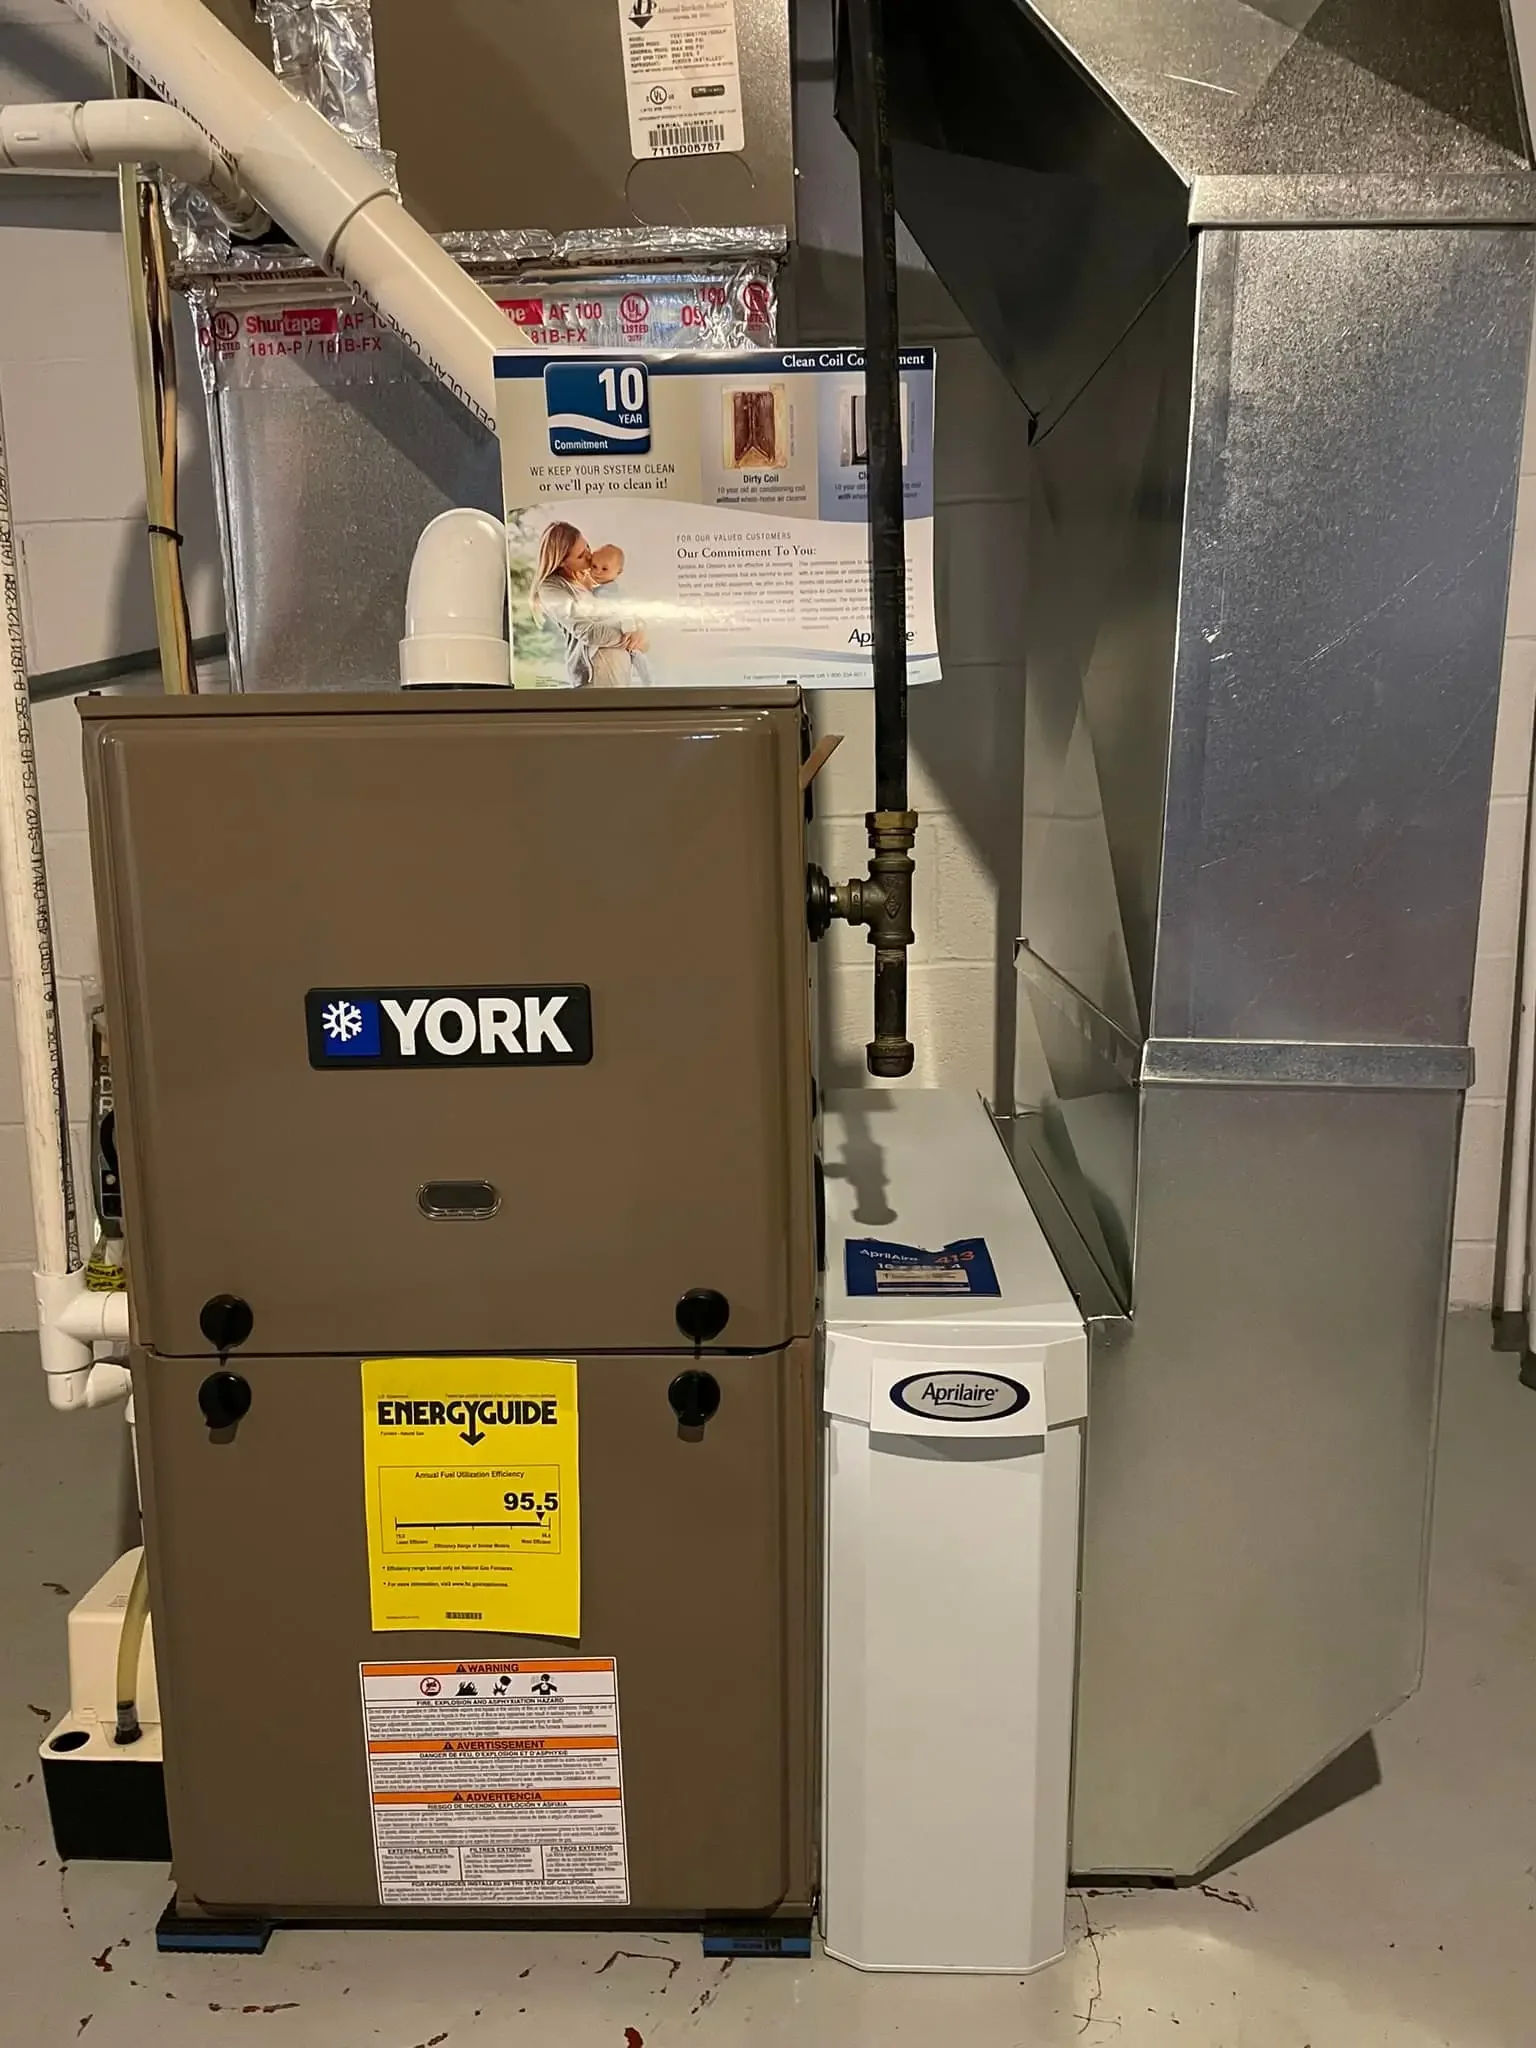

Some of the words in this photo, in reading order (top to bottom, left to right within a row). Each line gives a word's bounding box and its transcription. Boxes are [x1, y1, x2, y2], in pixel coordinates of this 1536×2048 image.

[549, 304, 570, 320] AF
[577, 302, 602, 319] 100
[246, 316, 322, 334] Shurtape
[343, 313, 364, 329] AF
[622, 324, 648, 333] LISTED
[532, 328, 586, 344] 81B-FX
[250, 343, 302, 356] 181A-P
[320, 337, 382, 353] 181B-FX
[782, 356, 816, 368] Clean
[819, 354, 844, 367] Coil
[847, 354, 924, 366] Coment
[599, 367, 644, 411] 10
[619, 414, 642, 424] YEAR
[554, 439, 608, 450] Commitment
[530, 466, 544, 476] WE
[549, 466, 572, 476] KEEP
[575, 465, 600, 475] YOUR
[603, 465, 641, 474] SYSTEM
[644, 464, 675, 473] CLEAN
[743, 475, 762, 484] Dirty
[764, 474, 779, 482] Coil
[539, 483, 551, 491] or
[555, 480, 581, 490] we'll
[585, 482, 605, 494] pay
[609, 480, 620, 490] to
[623, 479, 650, 489] clean
[656, 478, 668, 489] it!
[676, 534, 691, 542] FOR
[695, 534, 710, 542] OUR
[714, 533, 742, 541] VALUED
[746, 532, 792, 541] CUSTOMERS
[677, 548, 699, 558] Our
[702, 547, 771, 558] Commitment
[774, 546, 790, 556] To
[793, 545, 816, 556] You:
[380, 996, 573, 1055] YORK
[859, 1249, 918, 1261] AprilAire
[934, 1251, 975, 1263] 413
[921, 1382, 995, 1405] Aprilaire
[378, 1401, 557, 1426] ENERGYGUIDE
[492, 1470, 524, 1479] Efficiency
[504, 1492, 558, 1511] 95.5
[468, 1664, 519, 1672] WARNING
[457, 1741, 545, 1750] AVERTISSEMENT
[466, 1792, 543, 1801] ADVERTENCIA
